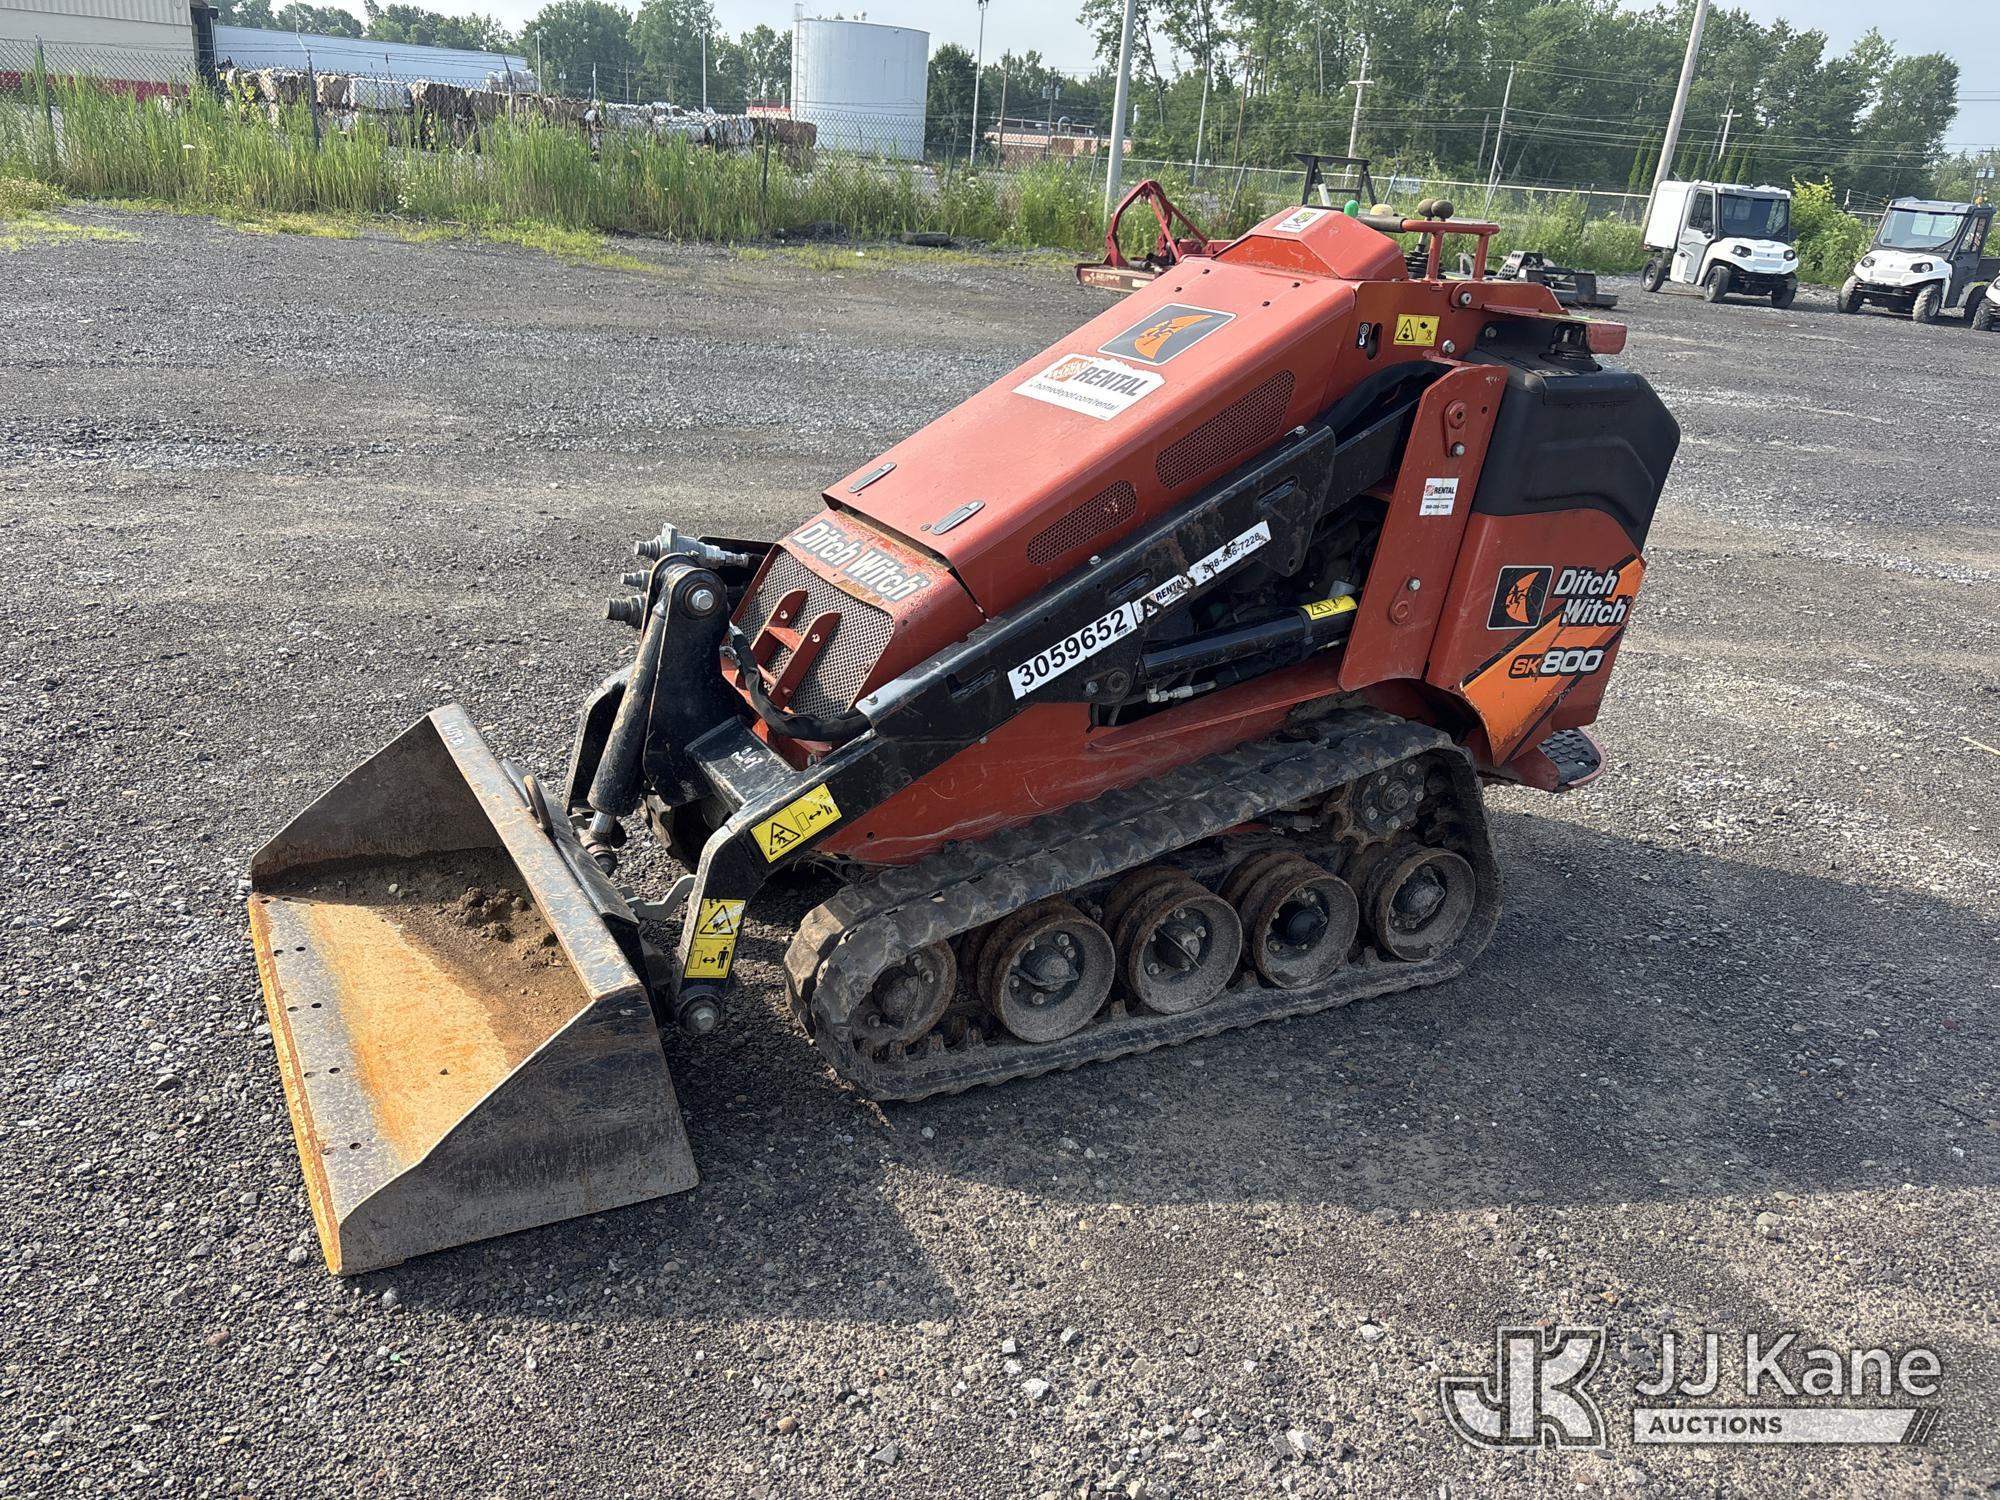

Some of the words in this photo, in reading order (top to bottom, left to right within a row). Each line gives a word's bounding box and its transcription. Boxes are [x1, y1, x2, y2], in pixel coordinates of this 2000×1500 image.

[1073, 366, 1148, 397] RENTAL
[1433, 486, 1455, 495] RENTAL
[792, 521, 861, 566] Ditch
[845, 550, 922, 601] Witch
[1155, 577, 1187, 602] RENTAL
[1553, 569, 1618, 595] Ditch
[1561, 598, 1628, 624] Witch
[1017, 609, 1128, 687] 3059652
[1511, 649, 1604, 675] SK800
